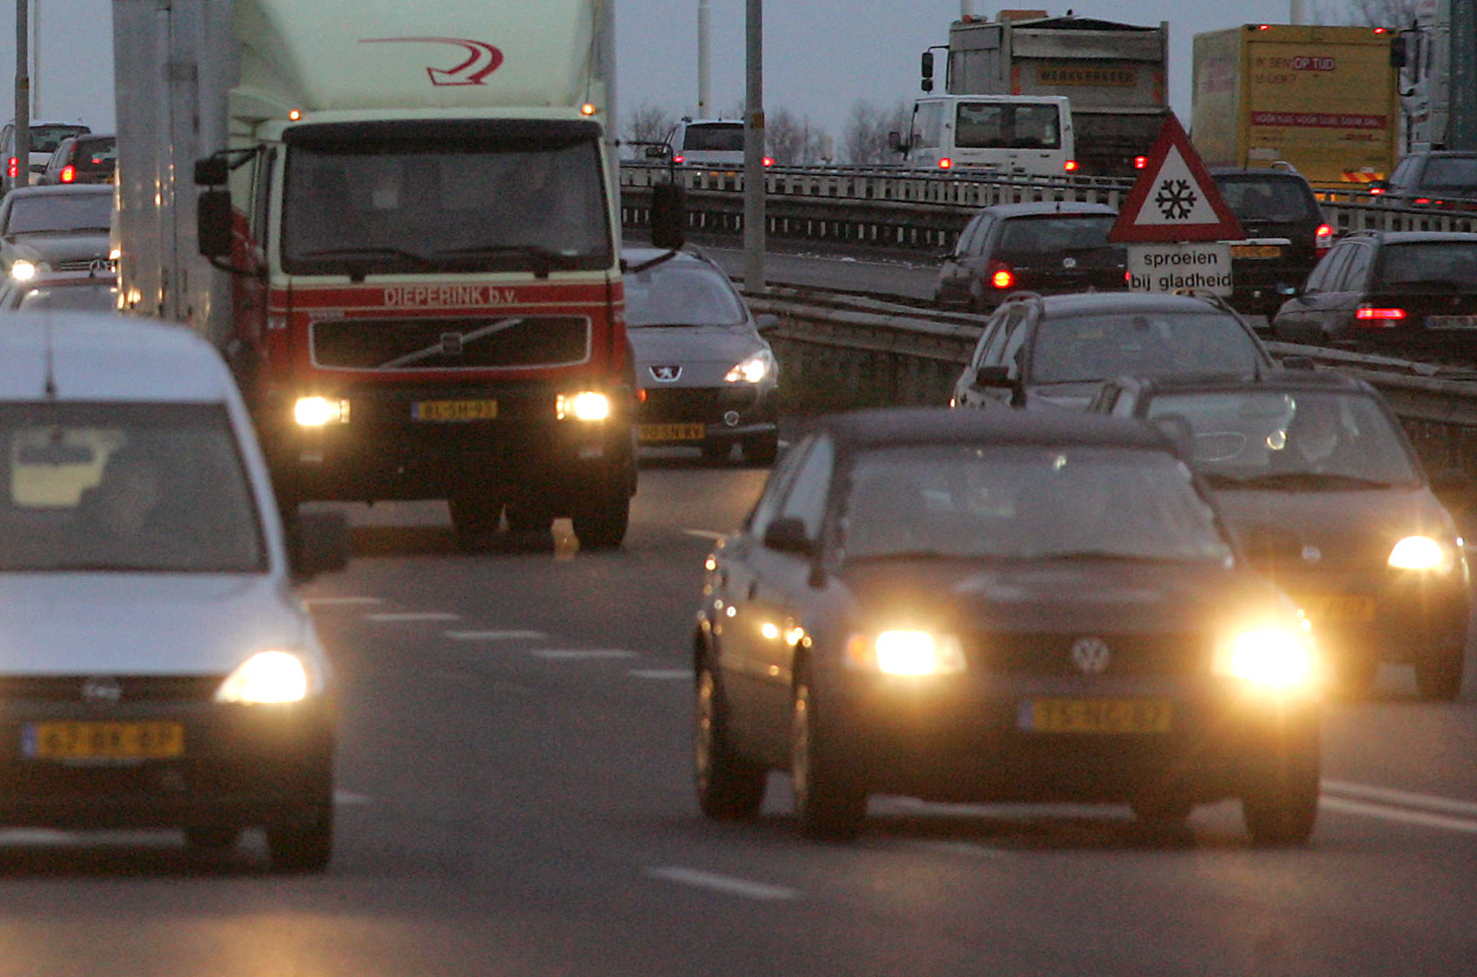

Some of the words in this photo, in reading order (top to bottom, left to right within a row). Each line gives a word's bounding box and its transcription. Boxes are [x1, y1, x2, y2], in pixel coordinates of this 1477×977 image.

[1294, 57, 1310, 69] OP
[1144, 251, 1217, 268] sproeien
[1131, 274, 1151, 291] bij
[1159, 273, 1231, 291] gladheid
[384, 286, 484, 306] DIEPERINK
